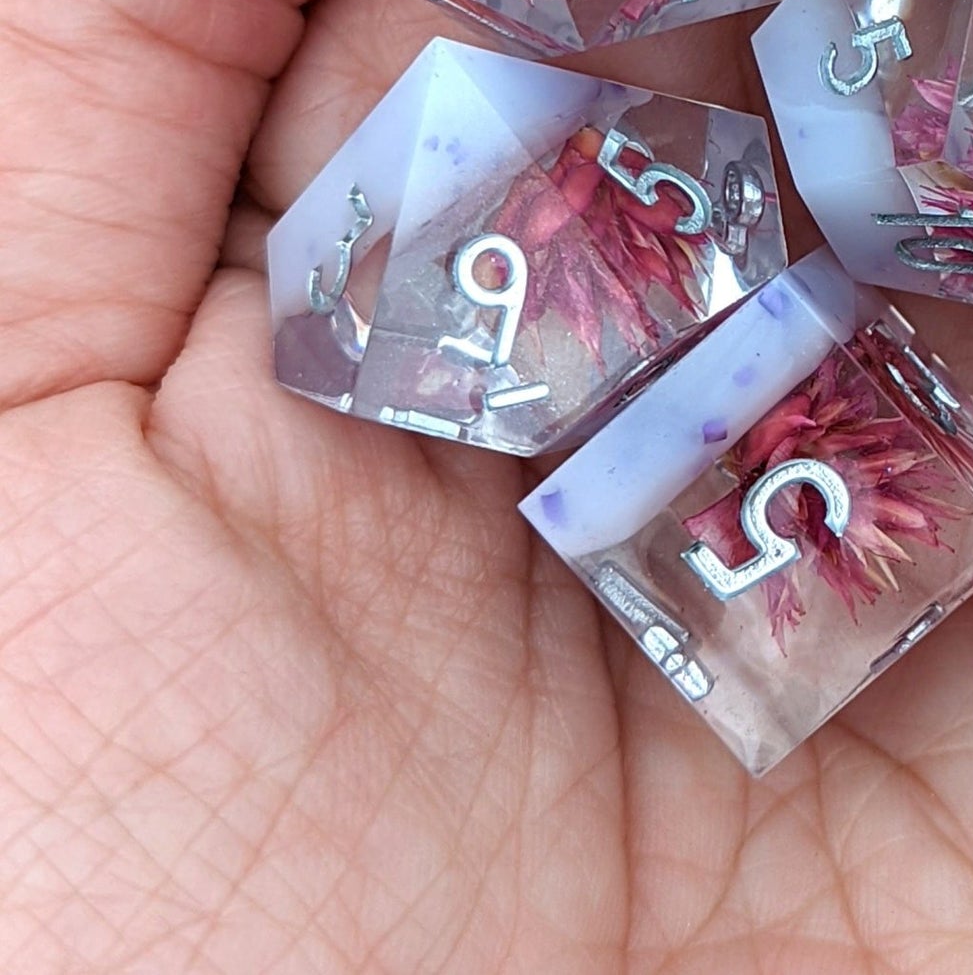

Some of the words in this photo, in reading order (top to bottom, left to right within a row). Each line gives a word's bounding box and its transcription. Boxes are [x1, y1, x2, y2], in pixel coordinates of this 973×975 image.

[818, 15, 914, 97] 5
[597, 128, 713, 235] 5
[680, 458, 853, 601] 5
